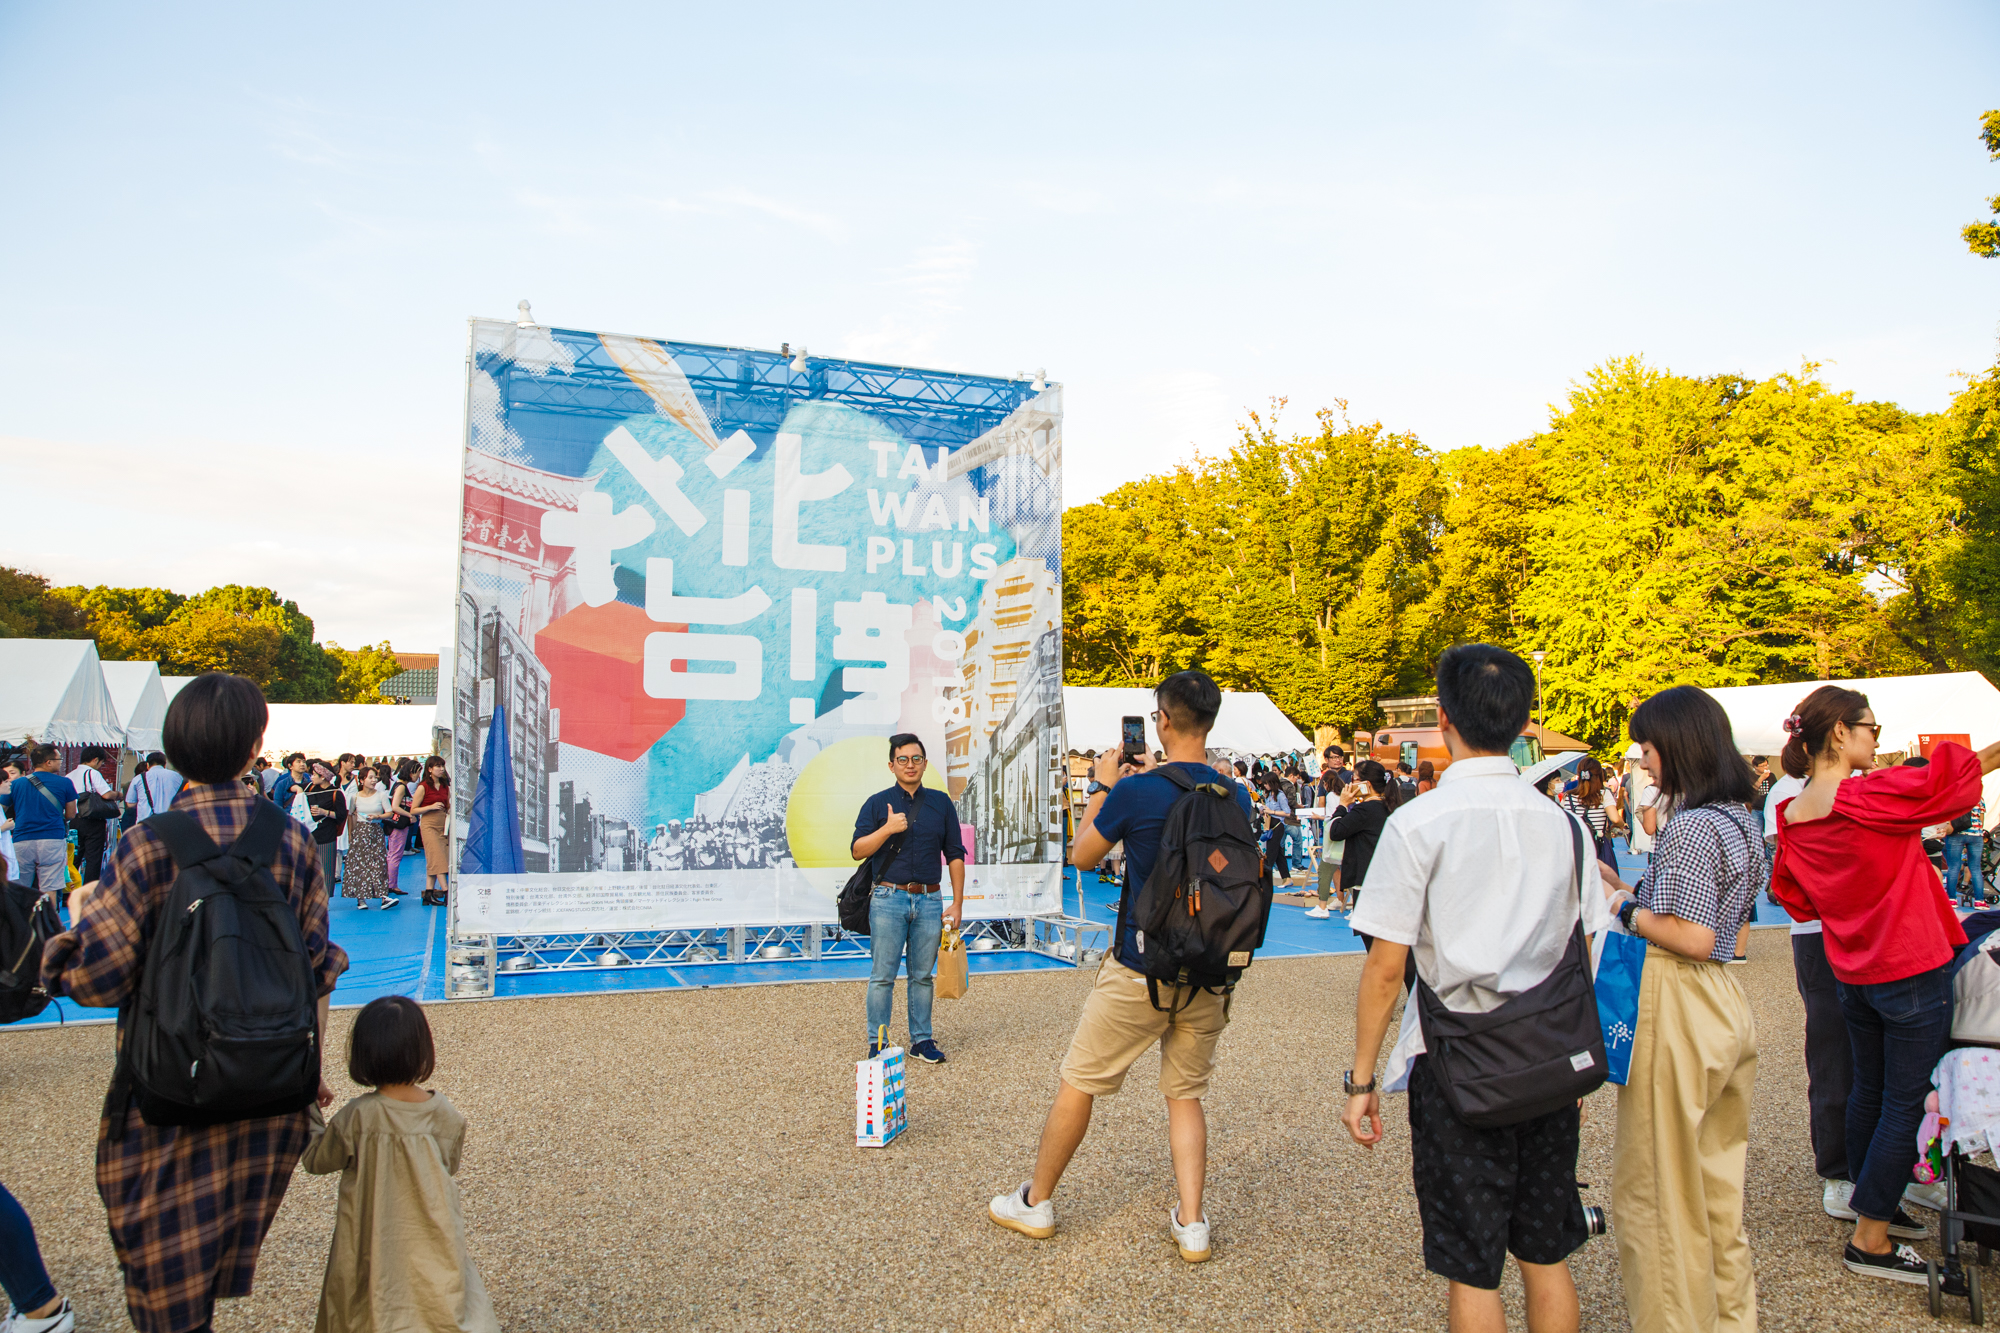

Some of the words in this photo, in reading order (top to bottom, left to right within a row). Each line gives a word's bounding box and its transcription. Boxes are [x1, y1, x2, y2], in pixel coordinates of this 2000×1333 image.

[868, 440, 949, 483] TAI
[866, 488, 990, 533] WAN
[866, 536, 998, 580] PLUS
[932, 595, 966, 725] 2018
